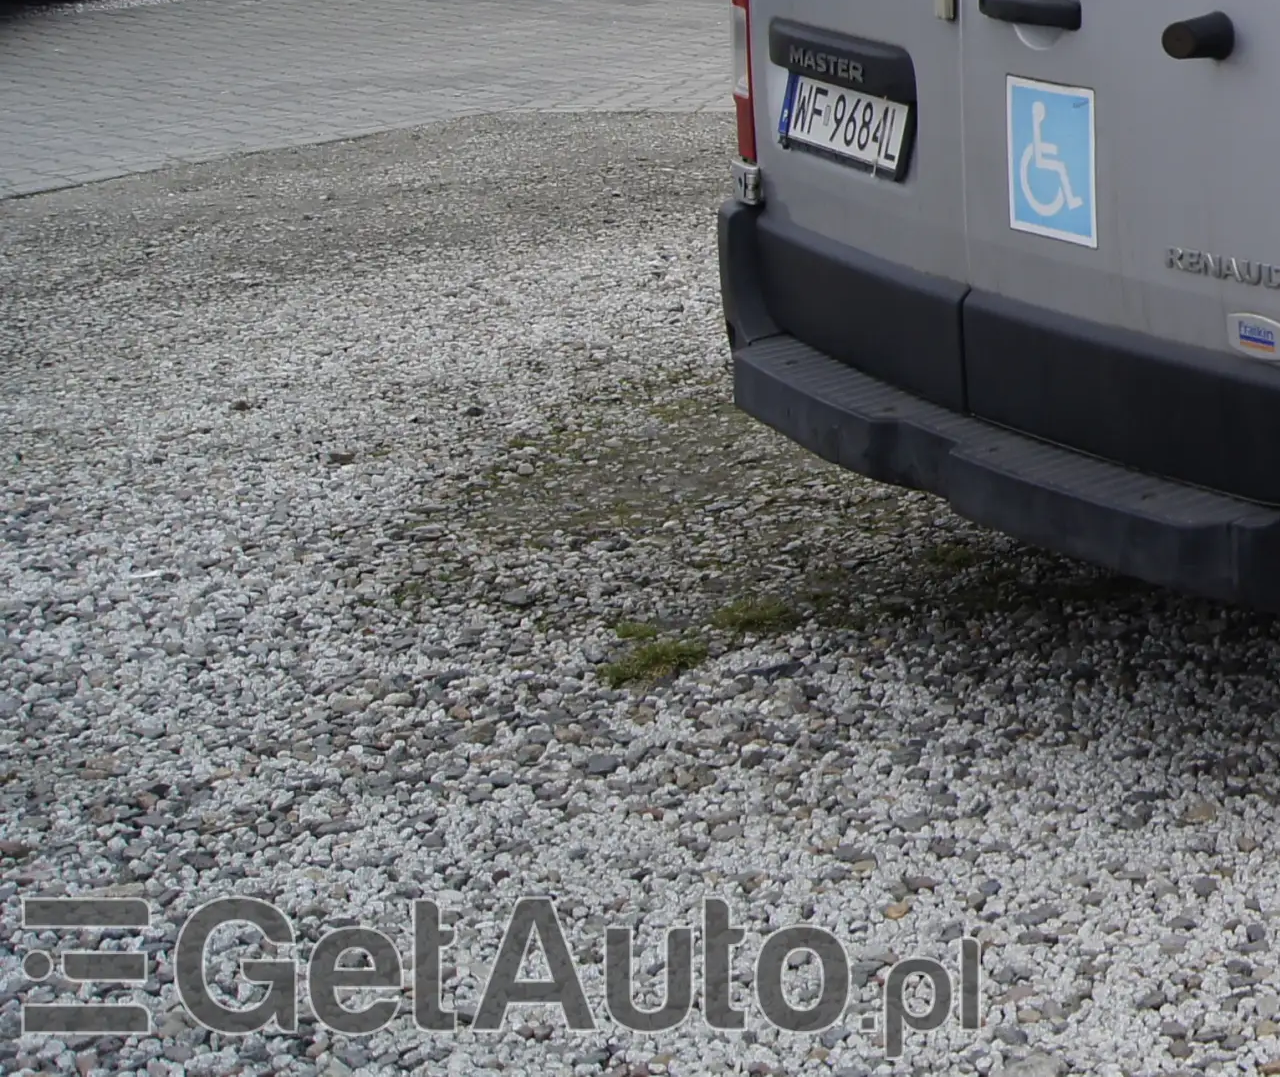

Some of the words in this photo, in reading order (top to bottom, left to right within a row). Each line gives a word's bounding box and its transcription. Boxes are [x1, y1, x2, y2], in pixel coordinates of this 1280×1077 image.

[789, 45, 865, 84] MASTER
[793, 82, 829, 134] WF
[829, 94, 896, 162] 9684L
